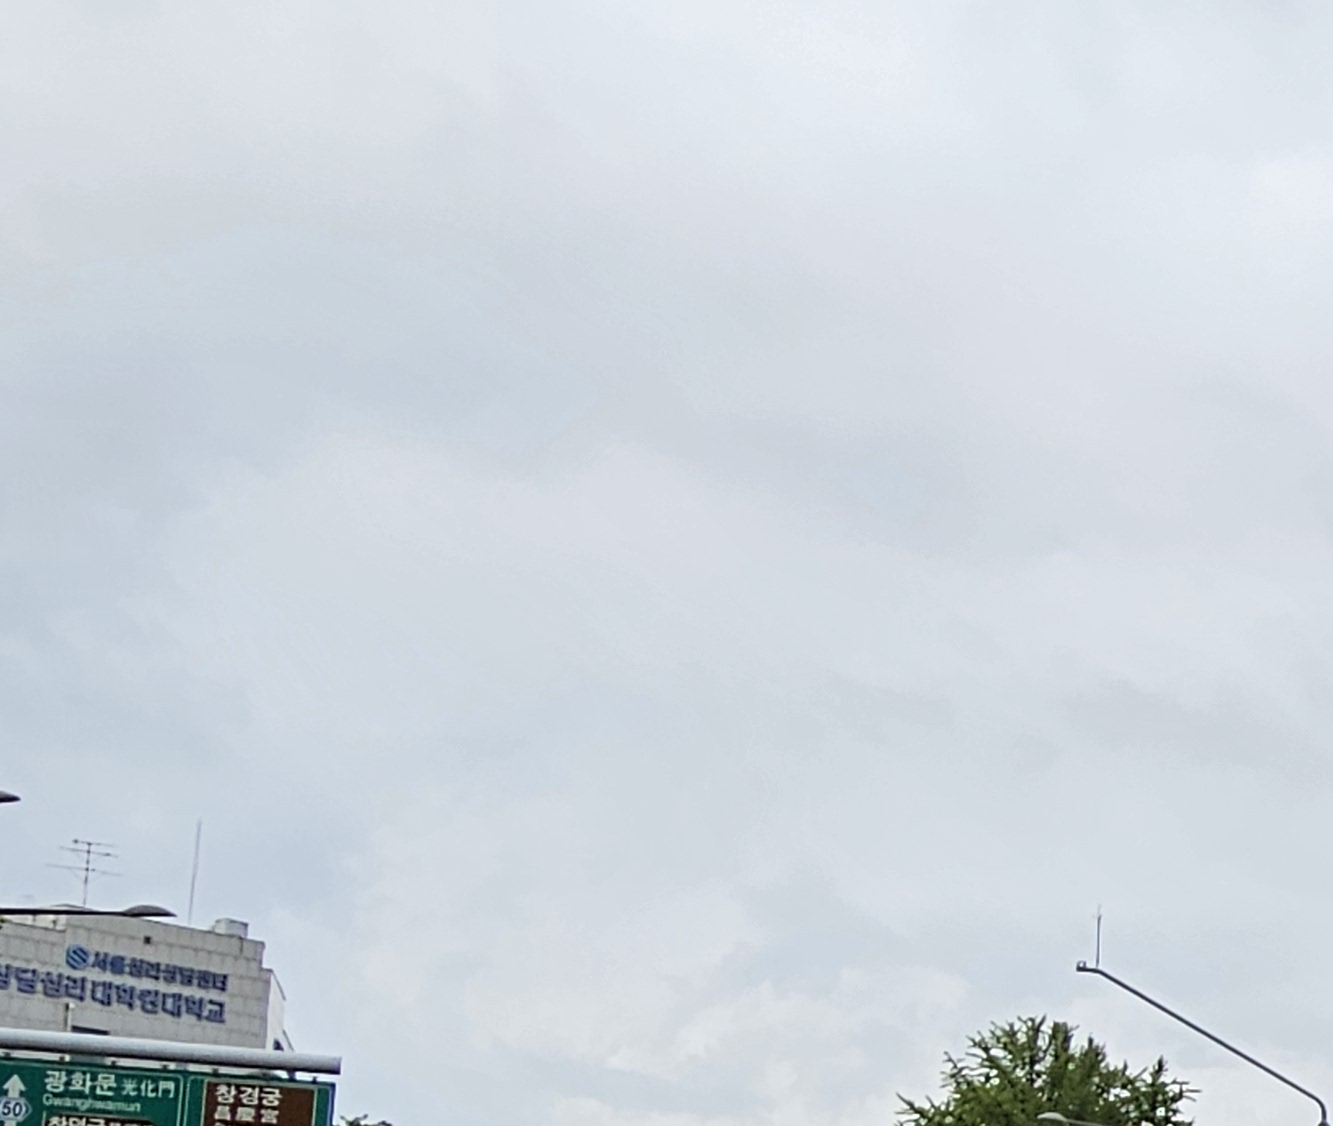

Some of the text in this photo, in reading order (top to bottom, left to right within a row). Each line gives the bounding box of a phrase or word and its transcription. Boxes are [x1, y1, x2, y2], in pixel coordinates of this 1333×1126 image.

[44, 1070, 175, 1099] 광화문 光化門
[215, 1083, 282, 1106] 창경궁
[2, 1102, 23, 1118] 50
[42, 1093, 141, 1112] Gwanghwamun
